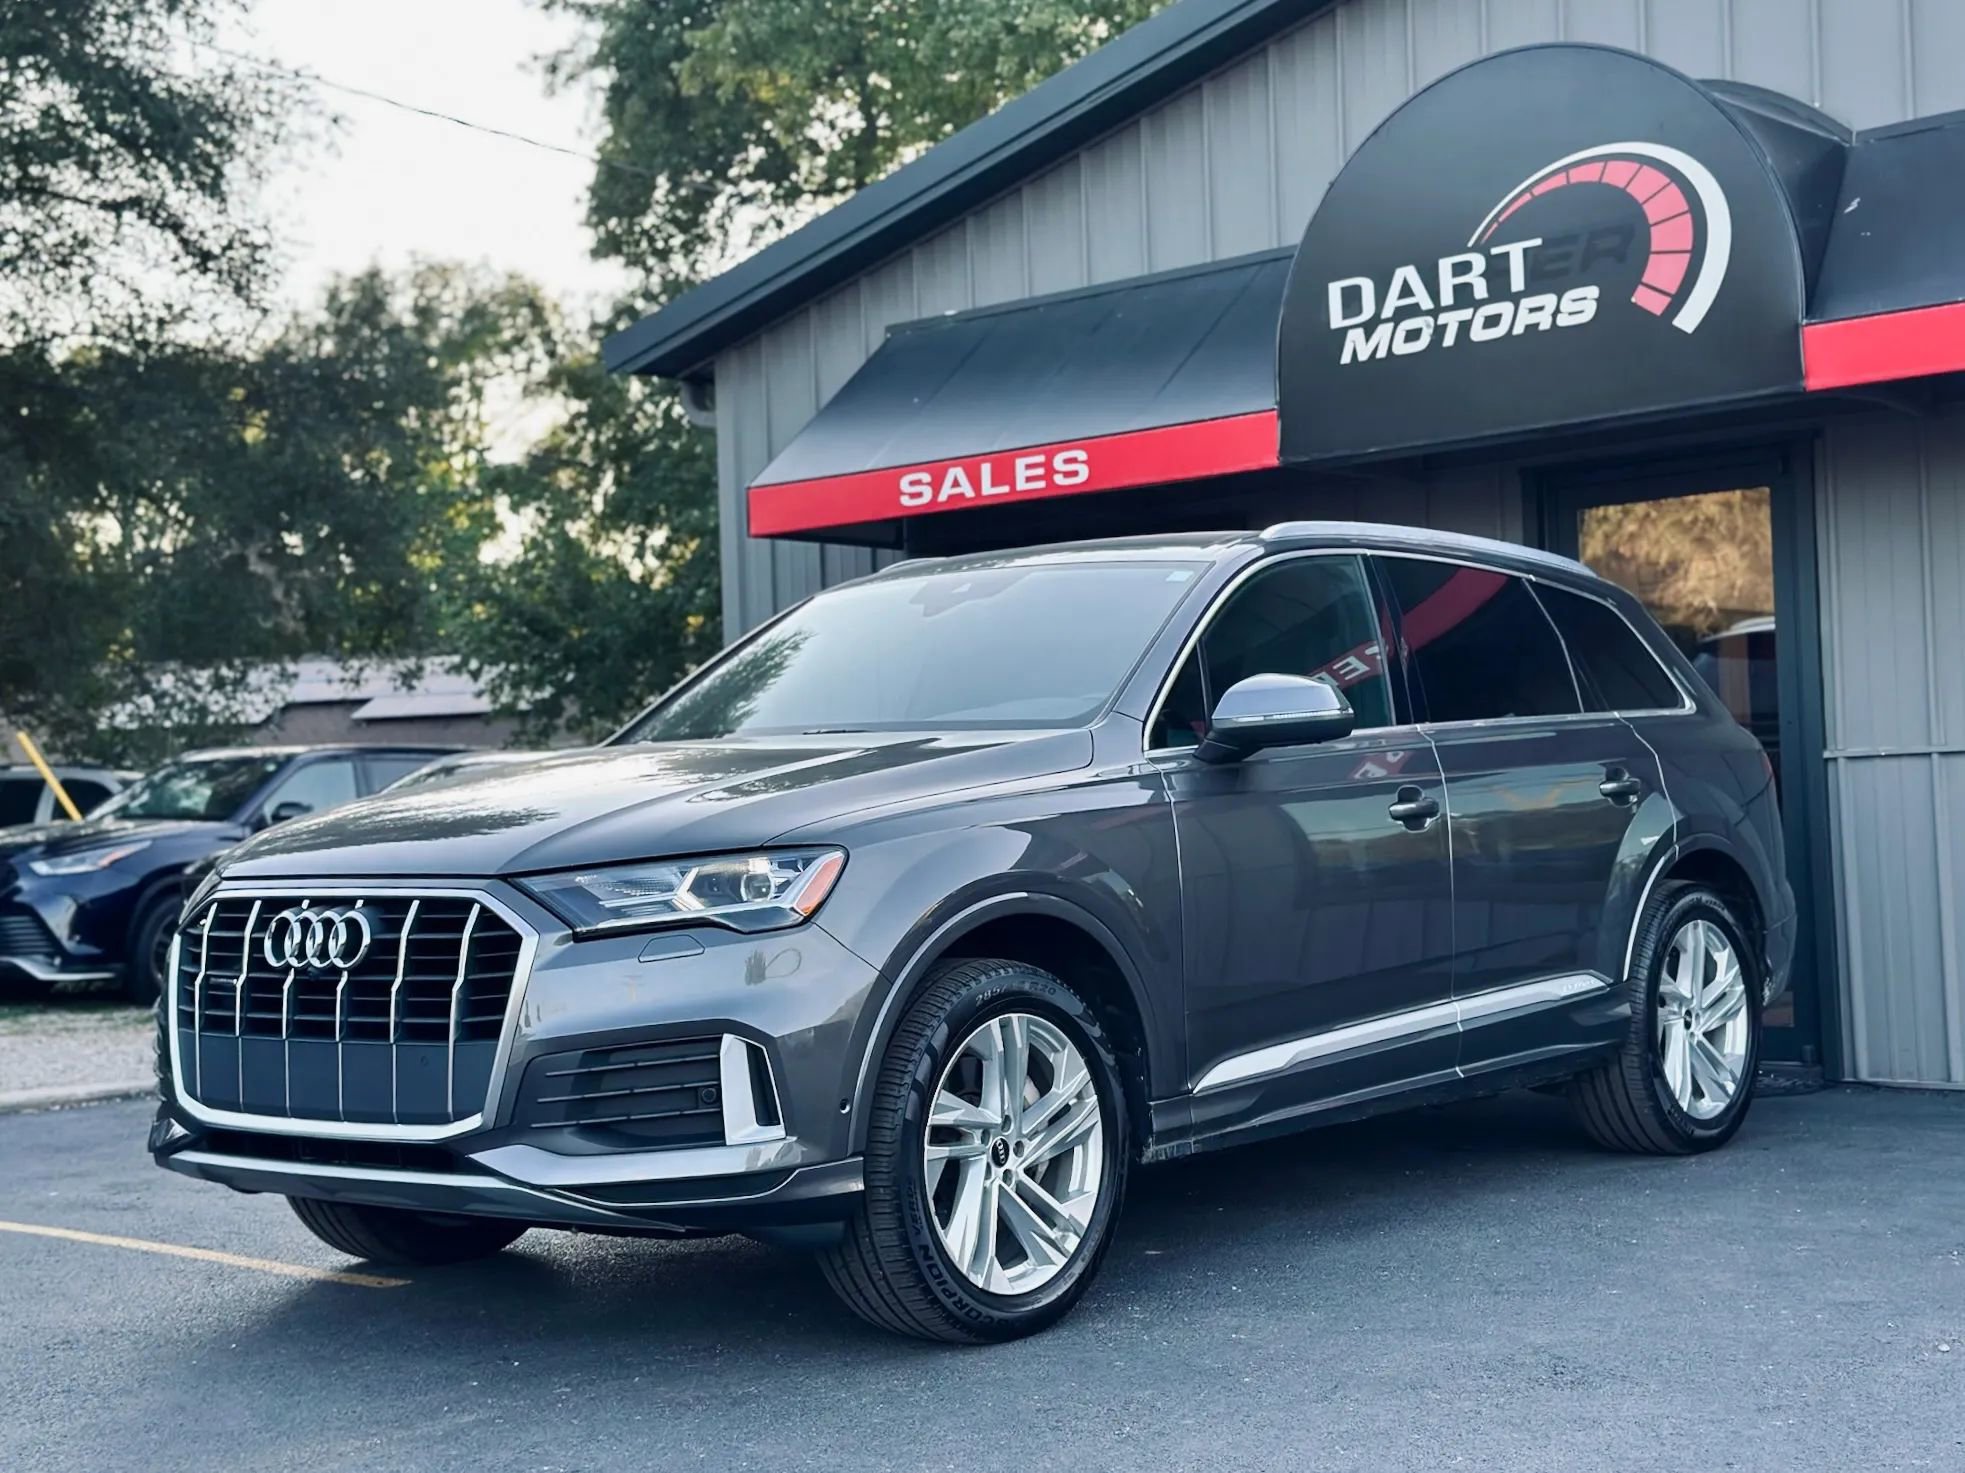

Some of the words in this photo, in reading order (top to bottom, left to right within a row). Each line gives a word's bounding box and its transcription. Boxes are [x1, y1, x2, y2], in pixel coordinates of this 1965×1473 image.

[1328, 237, 1543, 330] DART
[1339, 285, 1600, 365] MOTORS
[899, 449, 1090, 508] SALES
